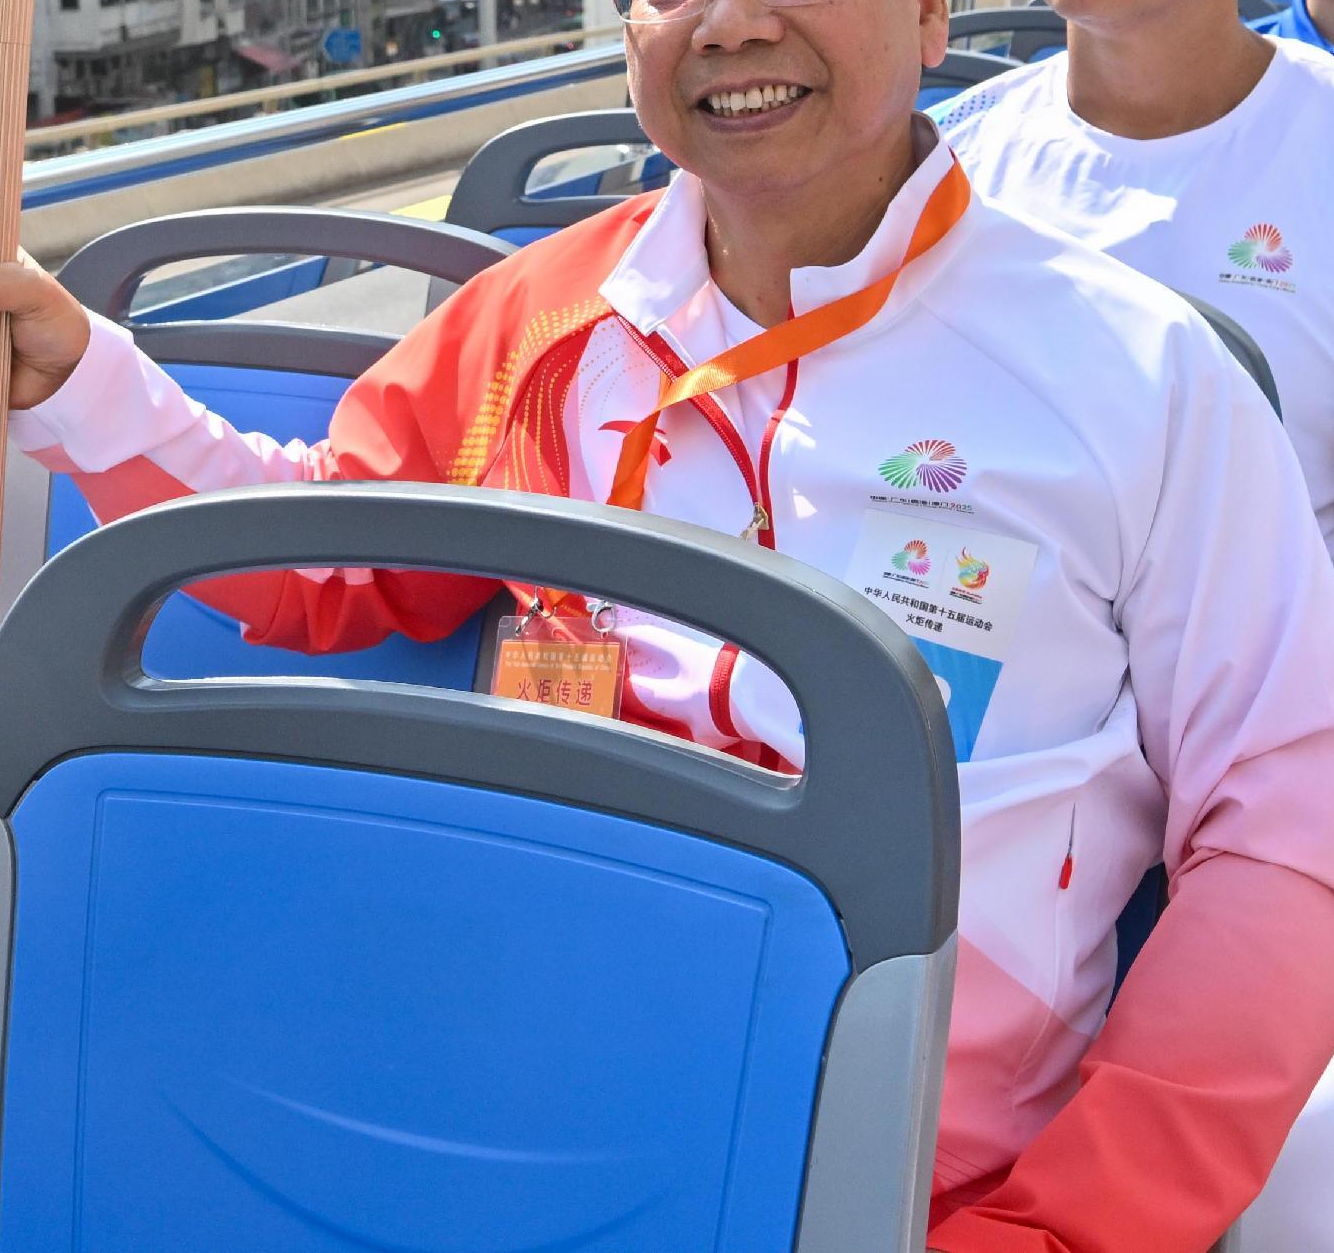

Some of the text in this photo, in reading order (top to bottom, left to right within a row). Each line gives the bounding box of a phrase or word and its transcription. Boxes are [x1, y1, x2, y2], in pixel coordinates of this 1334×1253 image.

[864, 586, 993, 631] 中华人民共和国第十五届运动会
[906, 613, 944, 633] 火炬传递
[516, 678, 592, 706] 火炬传递
